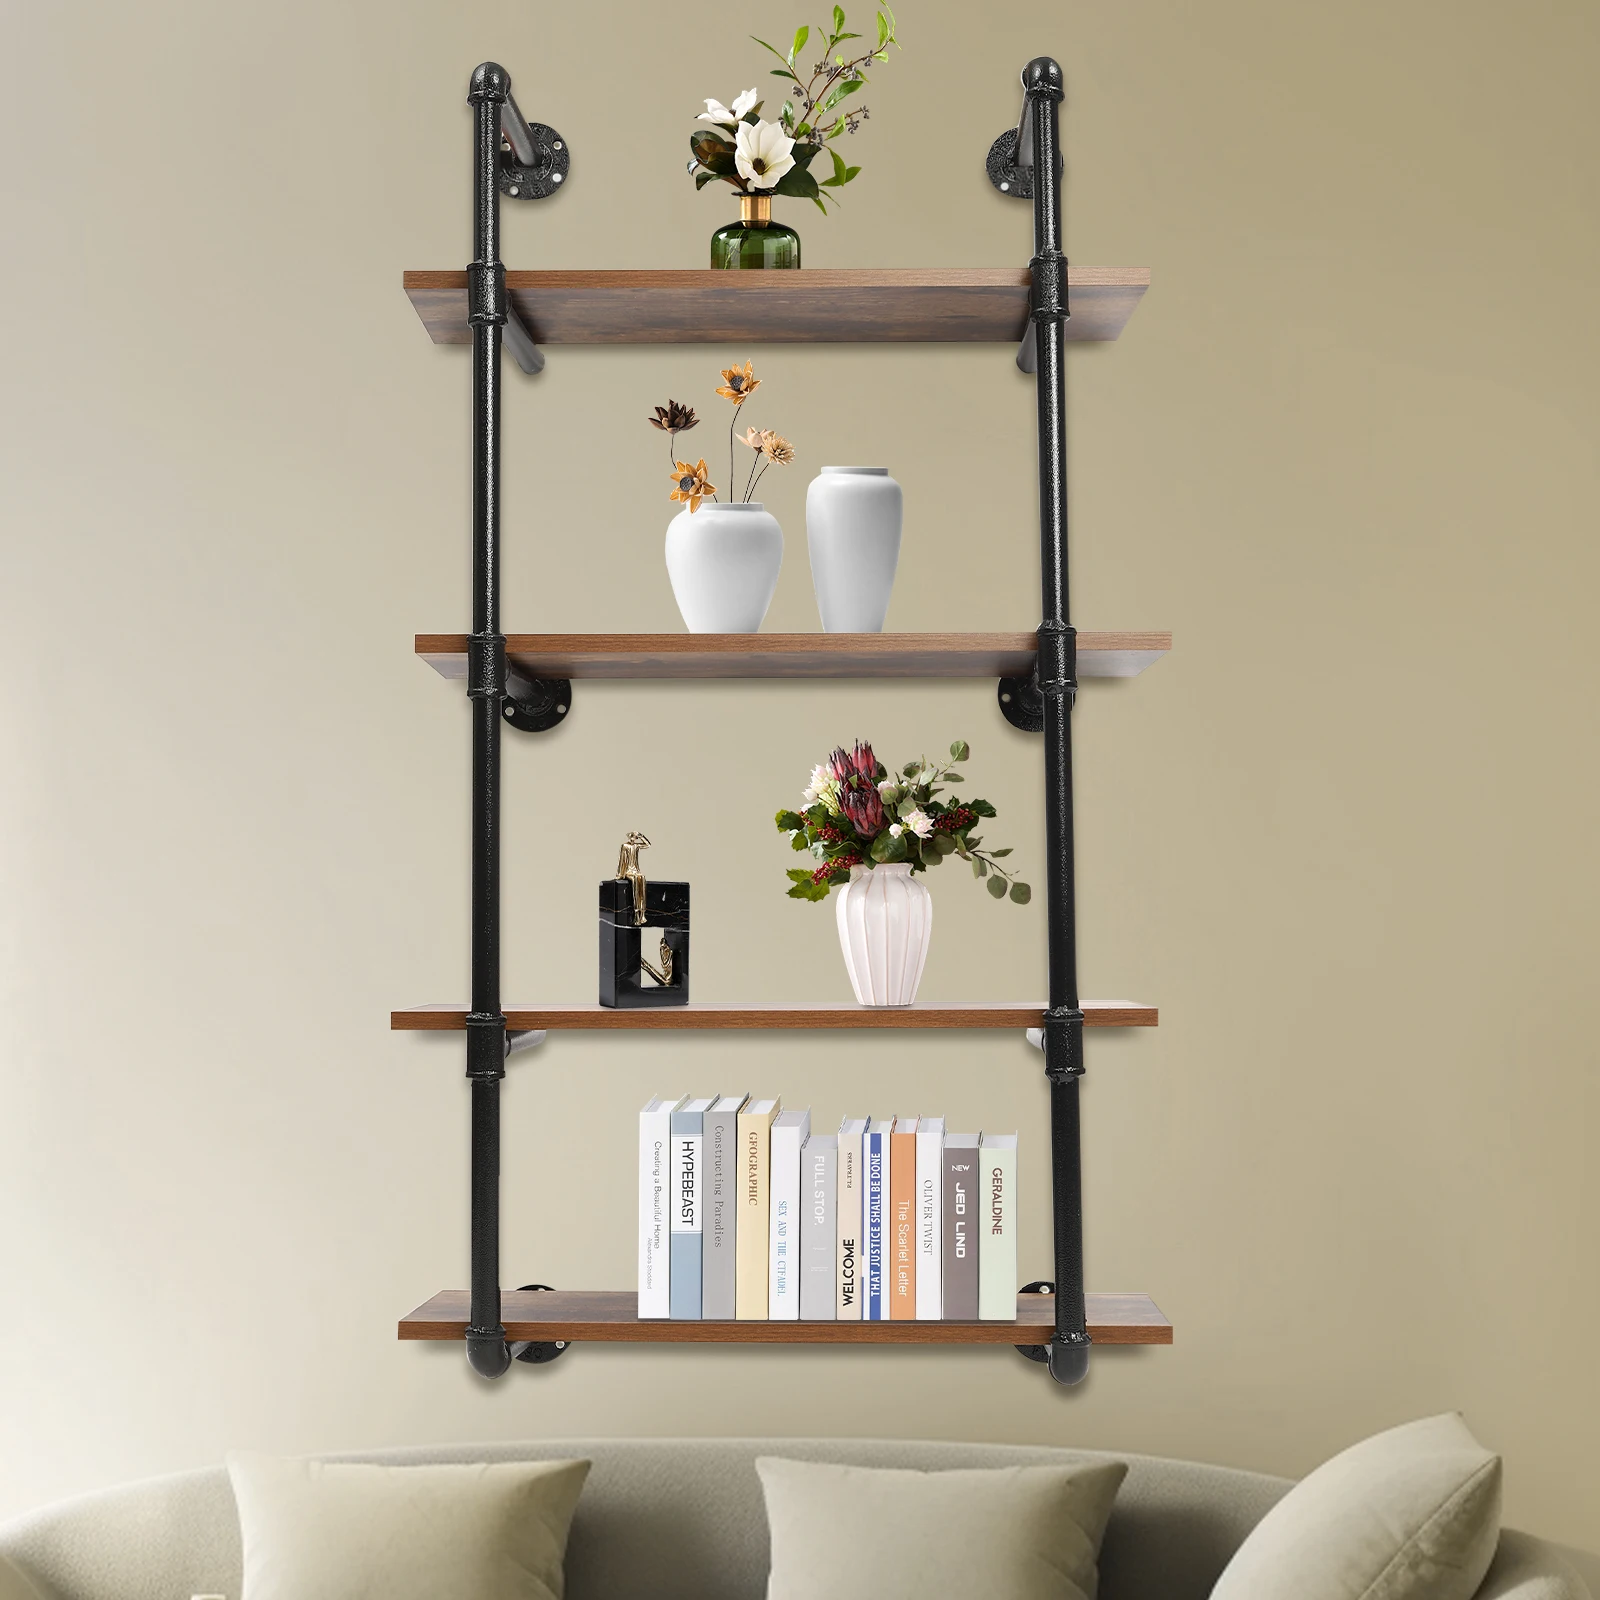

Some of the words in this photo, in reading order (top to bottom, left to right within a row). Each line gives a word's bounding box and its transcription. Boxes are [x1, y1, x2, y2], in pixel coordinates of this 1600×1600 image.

[652, 1141, 662, 1176] Creating
[713, 1125, 724, 1196] Constructing
[814, 1155, 825, 1188] FULL
[870, 1152, 881, 1179] DONE
[951, 1164, 970, 1172] NEW
[682, 1141, 694, 1226] HYPEBEAST
[870, 1181, 881, 1192] BE
[923, 1179, 933, 1220] OLIVER
[955, 1182, 966, 1215] JED
[991, 1167, 1003, 1235] GERALDINE
[653, 1185, 662, 1222] Beautiful
[778, 1200, 787, 1216] SEX
[814, 1190, 825, 1226] STOP.
[870, 1194, 881, 1223] SHALL
[898, 1199, 910, 1221] The
[653, 1224, 661, 1249] Home
[714, 1201, 724, 1248] Paradies
[777, 1220, 787, 1237] AND
[923, 1221, 933, 1256] TWIST
[955, 1221, 966, 1258] LIND
[870, 1226, 881, 1267] JUSTICE
[898, 1223, 910, 1262] Scarlet
[842, 1238, 855, 1307] WELCOME
[870, 1270, 880, 1297] THAT
[898, 1265, 910, 1297] Letter
